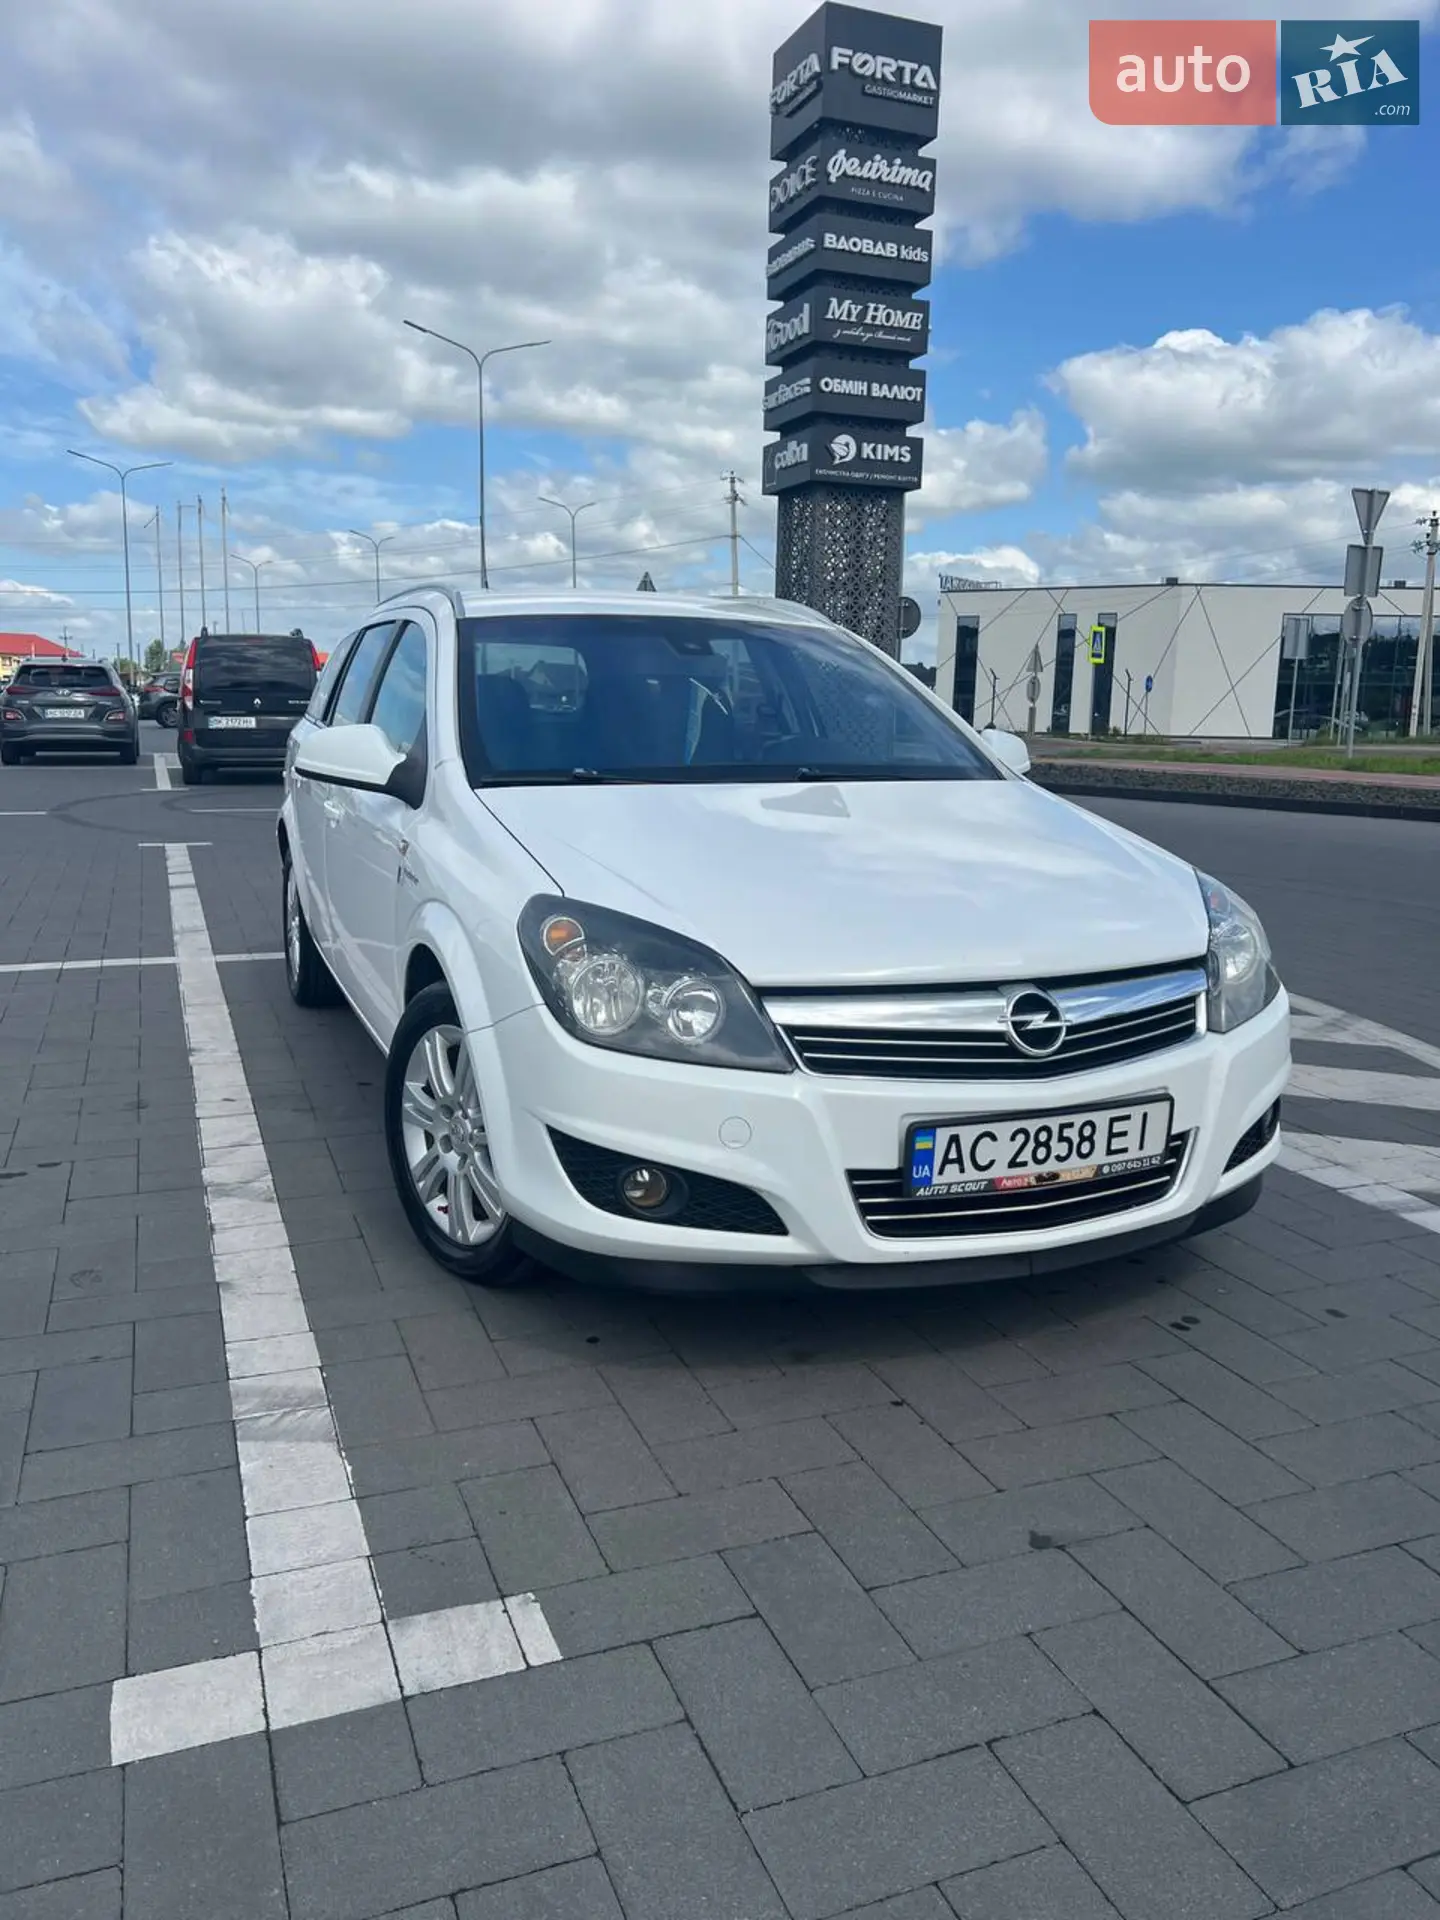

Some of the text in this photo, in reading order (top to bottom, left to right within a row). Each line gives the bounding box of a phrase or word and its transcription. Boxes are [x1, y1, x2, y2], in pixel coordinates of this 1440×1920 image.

[864, 83, 935, 106] GASTROMARKET
[823, 233, 898, 259] BAOBAB
[900, 245, 929, 263] kids
[820, 376, 923, 402] ОБМІН ВАЛЮТ
[861, 442, 912, 463] KIMS
[938, 1111, 1149, 1176] AC 2858 EI
[912, 1165, 931, 1178] UA
[916, 1180, 989, 1197] AUTO SCOUT
